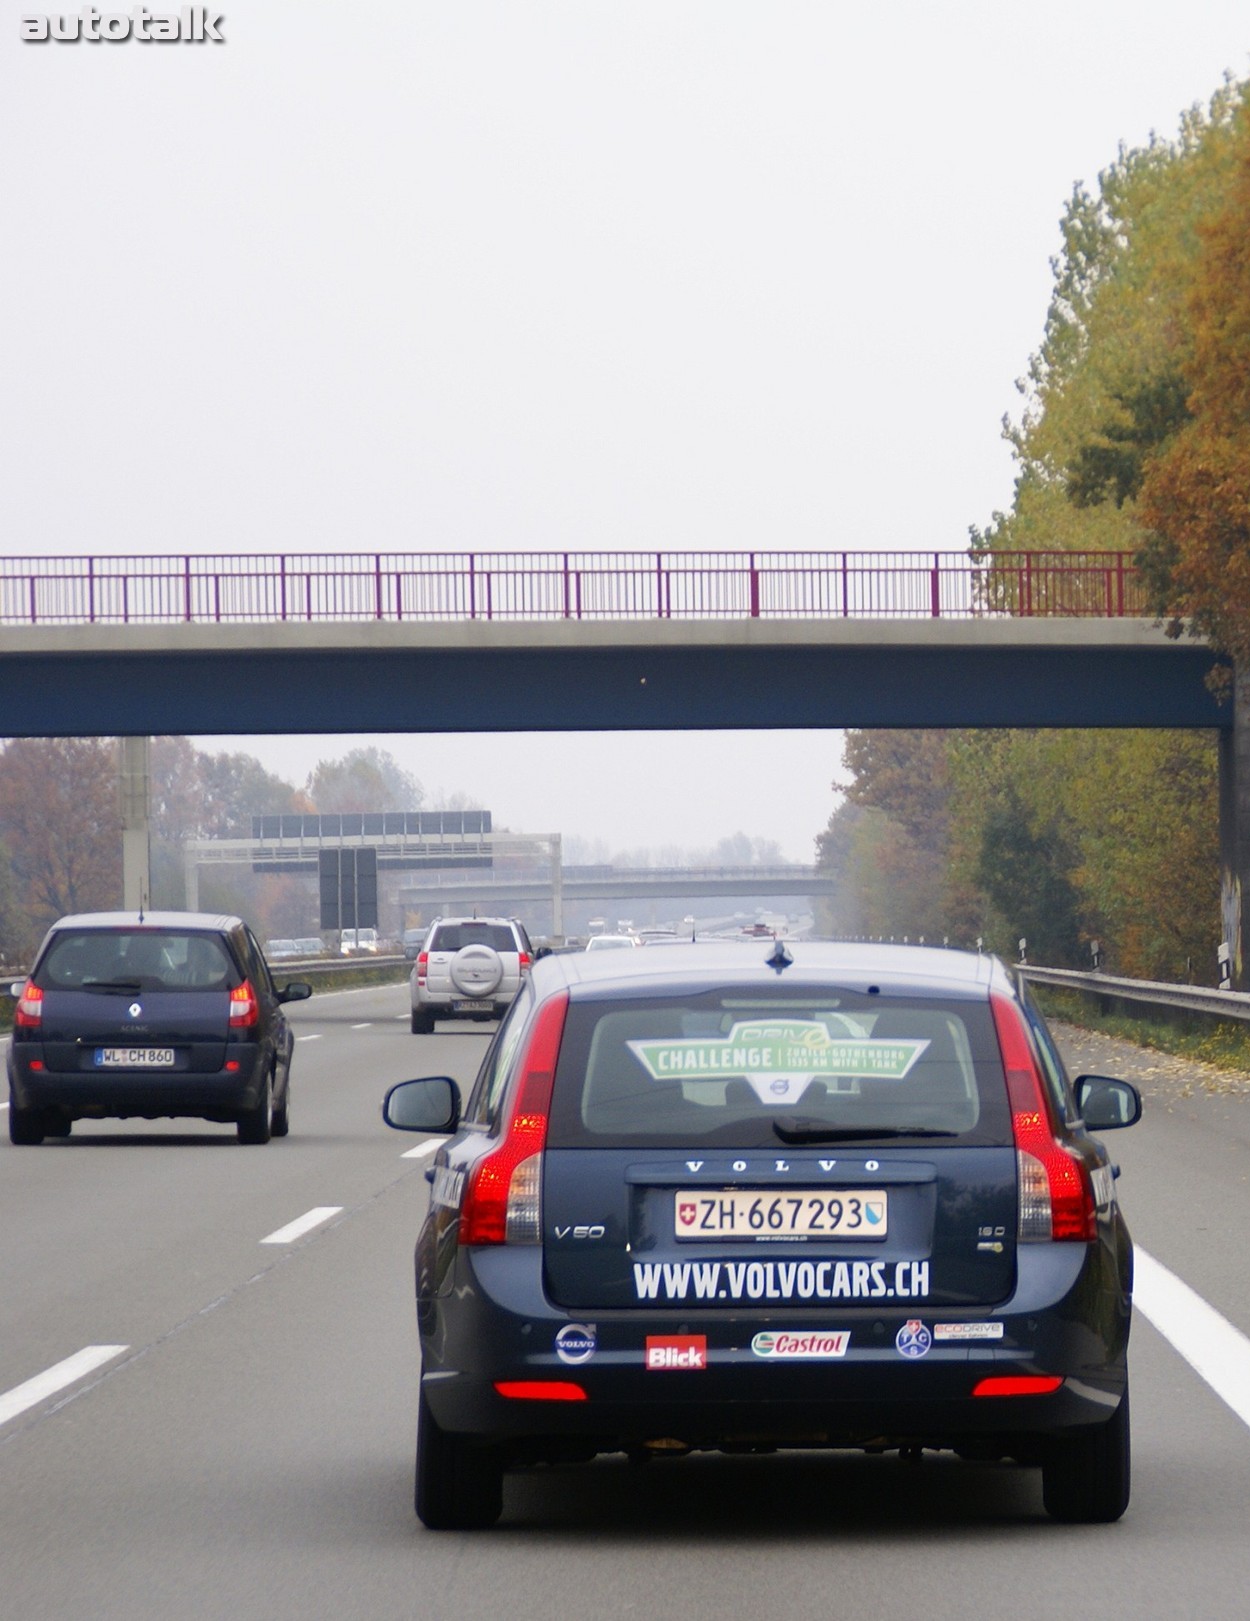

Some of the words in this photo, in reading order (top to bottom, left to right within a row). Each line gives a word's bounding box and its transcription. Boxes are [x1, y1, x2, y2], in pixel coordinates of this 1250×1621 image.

[104, 1050, 120, 1062] WL
[129, 1050, 146, 1062] CH
[148, 1050, 172, 1062] 860
[658, 1047, 772, 1070] CHALLENGE
[832, 1058, 858, 1068] WITH
[871, 1059, 898, 1069] TANK
[686, 1160, 880, 1172] VOLVO
[633, 1261, 930, 1299] WWW.VOLVOCARS.CH
[557, 1340, 595, 1348] VOLVO
[775, 1334, 842, 1353] Castrol
[649, 1346, 703, 1368] Blick
